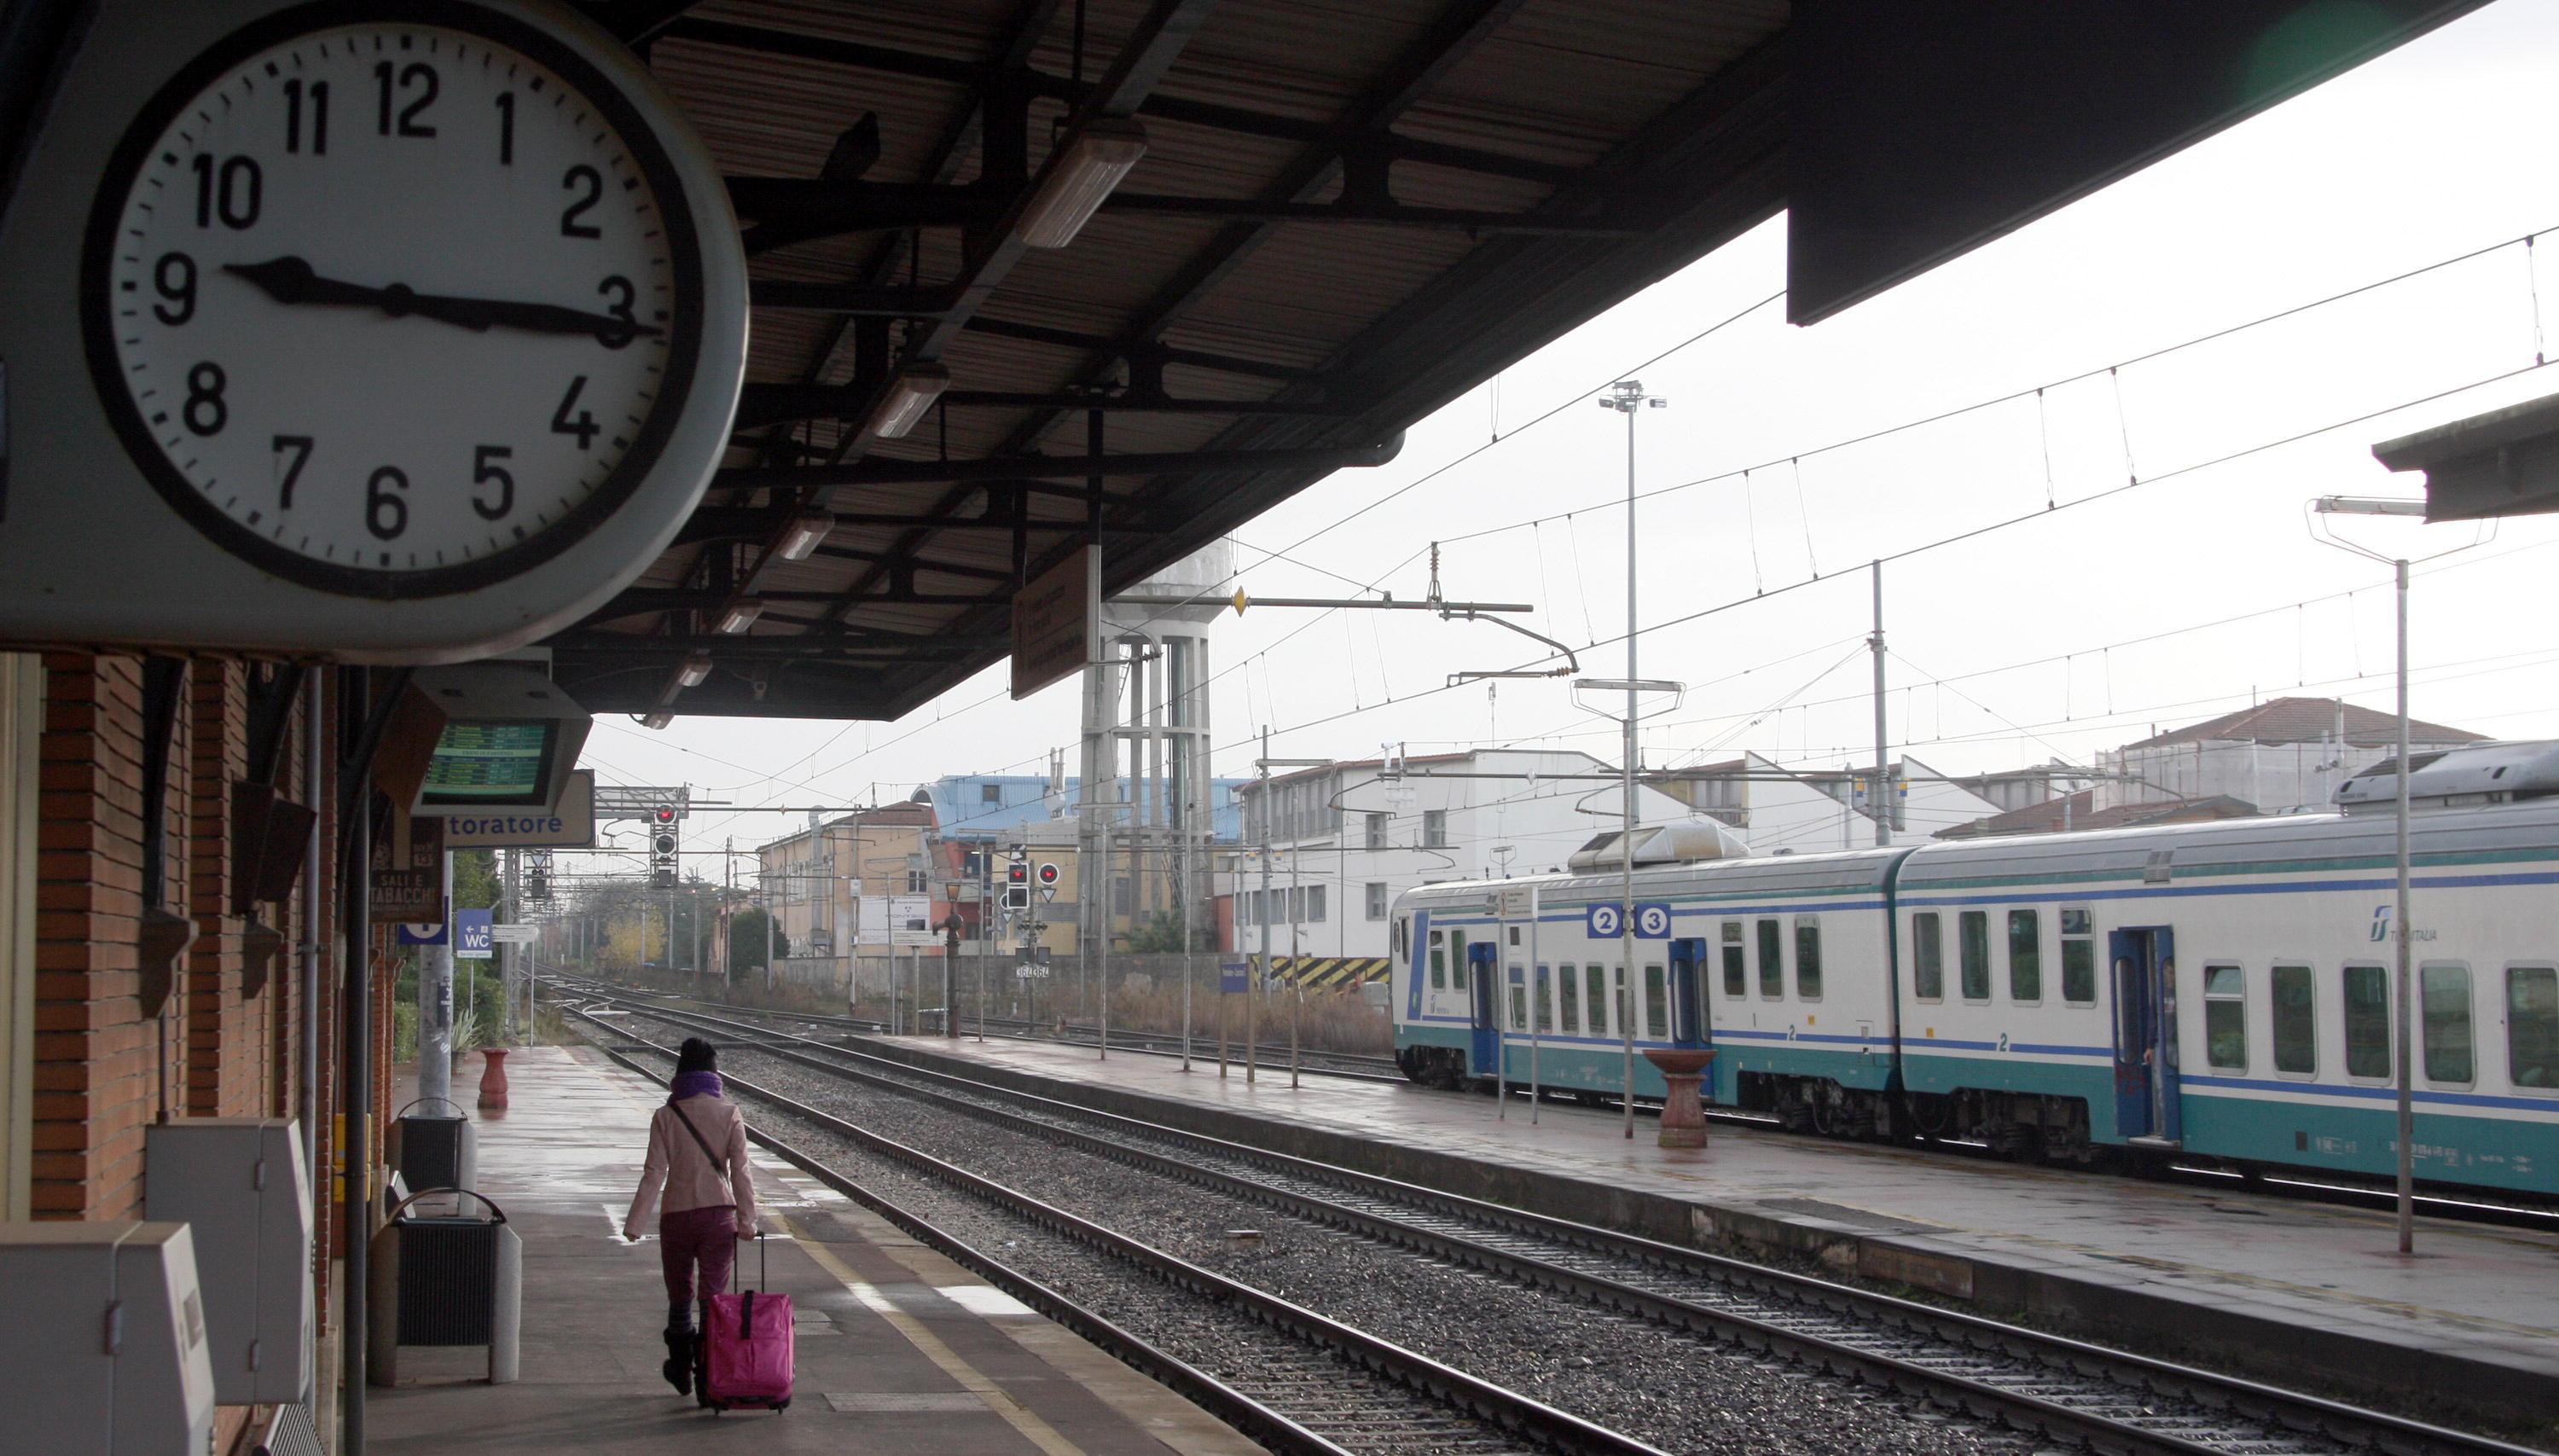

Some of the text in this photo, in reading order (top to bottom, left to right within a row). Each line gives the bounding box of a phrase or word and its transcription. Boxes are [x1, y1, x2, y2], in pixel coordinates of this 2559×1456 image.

[284, 79, 328, 154] 11
[374, 62, 438, 138] 12
[496, 91, 516, 165] 1
[192, 153, 262, 229] 10
[560, 165, 601, 238] 2
[154, 252, 197, 326] 9
[597, 276, 635, 349] 3
[183, 362, 227, 436] 8
[551, 377, 600, 450] 4
[272, 436, 314, 510] 7
[366, 467, 408, 540] 6
[473, 446, 514, 519] 5
[446, 816, 562, 834] toratore
[465, 935, 489, 948] WC
[1599, 913, 1612, 929] 2
[1647, 913, 1661, 930] 3
[1789, 1024, 1796, 1041] 2
[2000, 1033, 2008, 1052] 2
